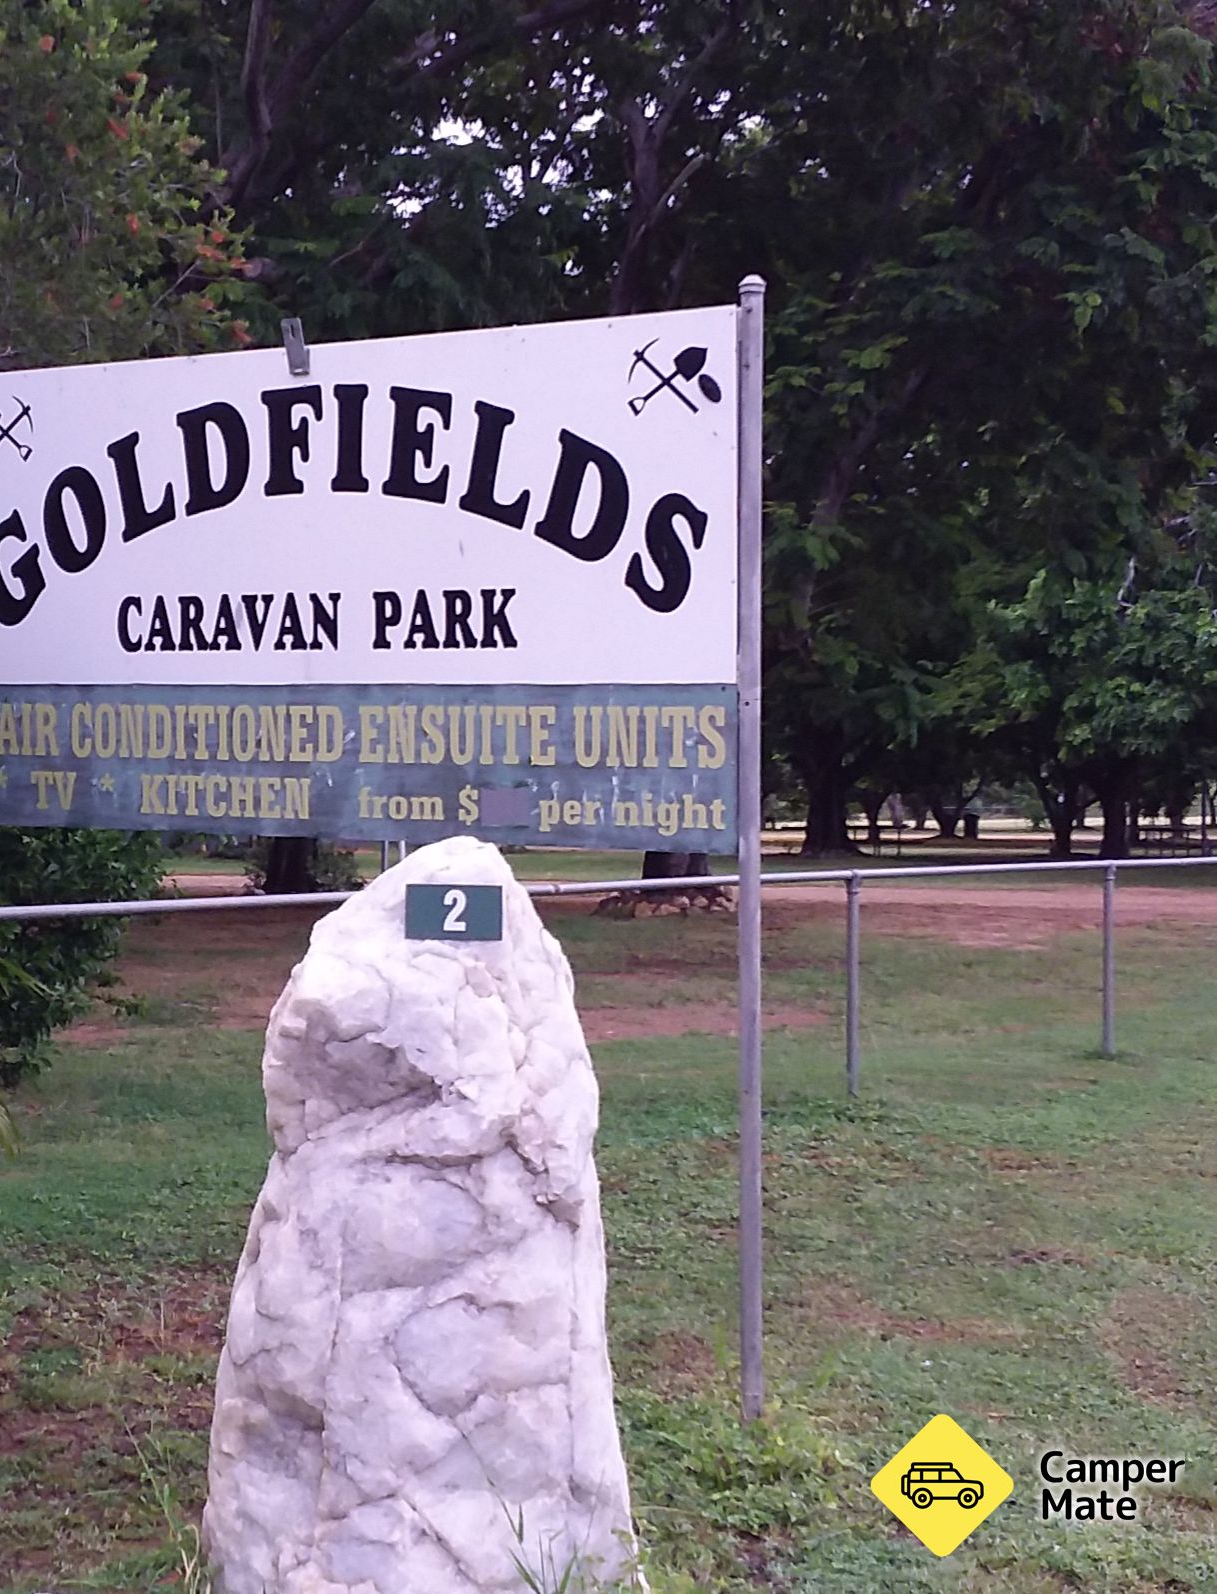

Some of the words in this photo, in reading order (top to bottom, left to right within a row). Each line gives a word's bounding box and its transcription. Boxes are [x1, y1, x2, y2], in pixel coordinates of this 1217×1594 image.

[117, 591, 341, 653] CARAVAN
[372, 588, 518, 650] PARK
[70, 703, 344, 763] CONDITIONED
[358, 704, 557, 767] ENSUITE
[572, 704, 727, 770] UNITS
[30, 770, 77, 811] TV
[139, 773, 311, 820] KITCHEN
[358, 787, 445, 821] from
[538, 798, 601, 833] per
[615, 792, 727, 837] night
[442, 889, 468, 933] 2
